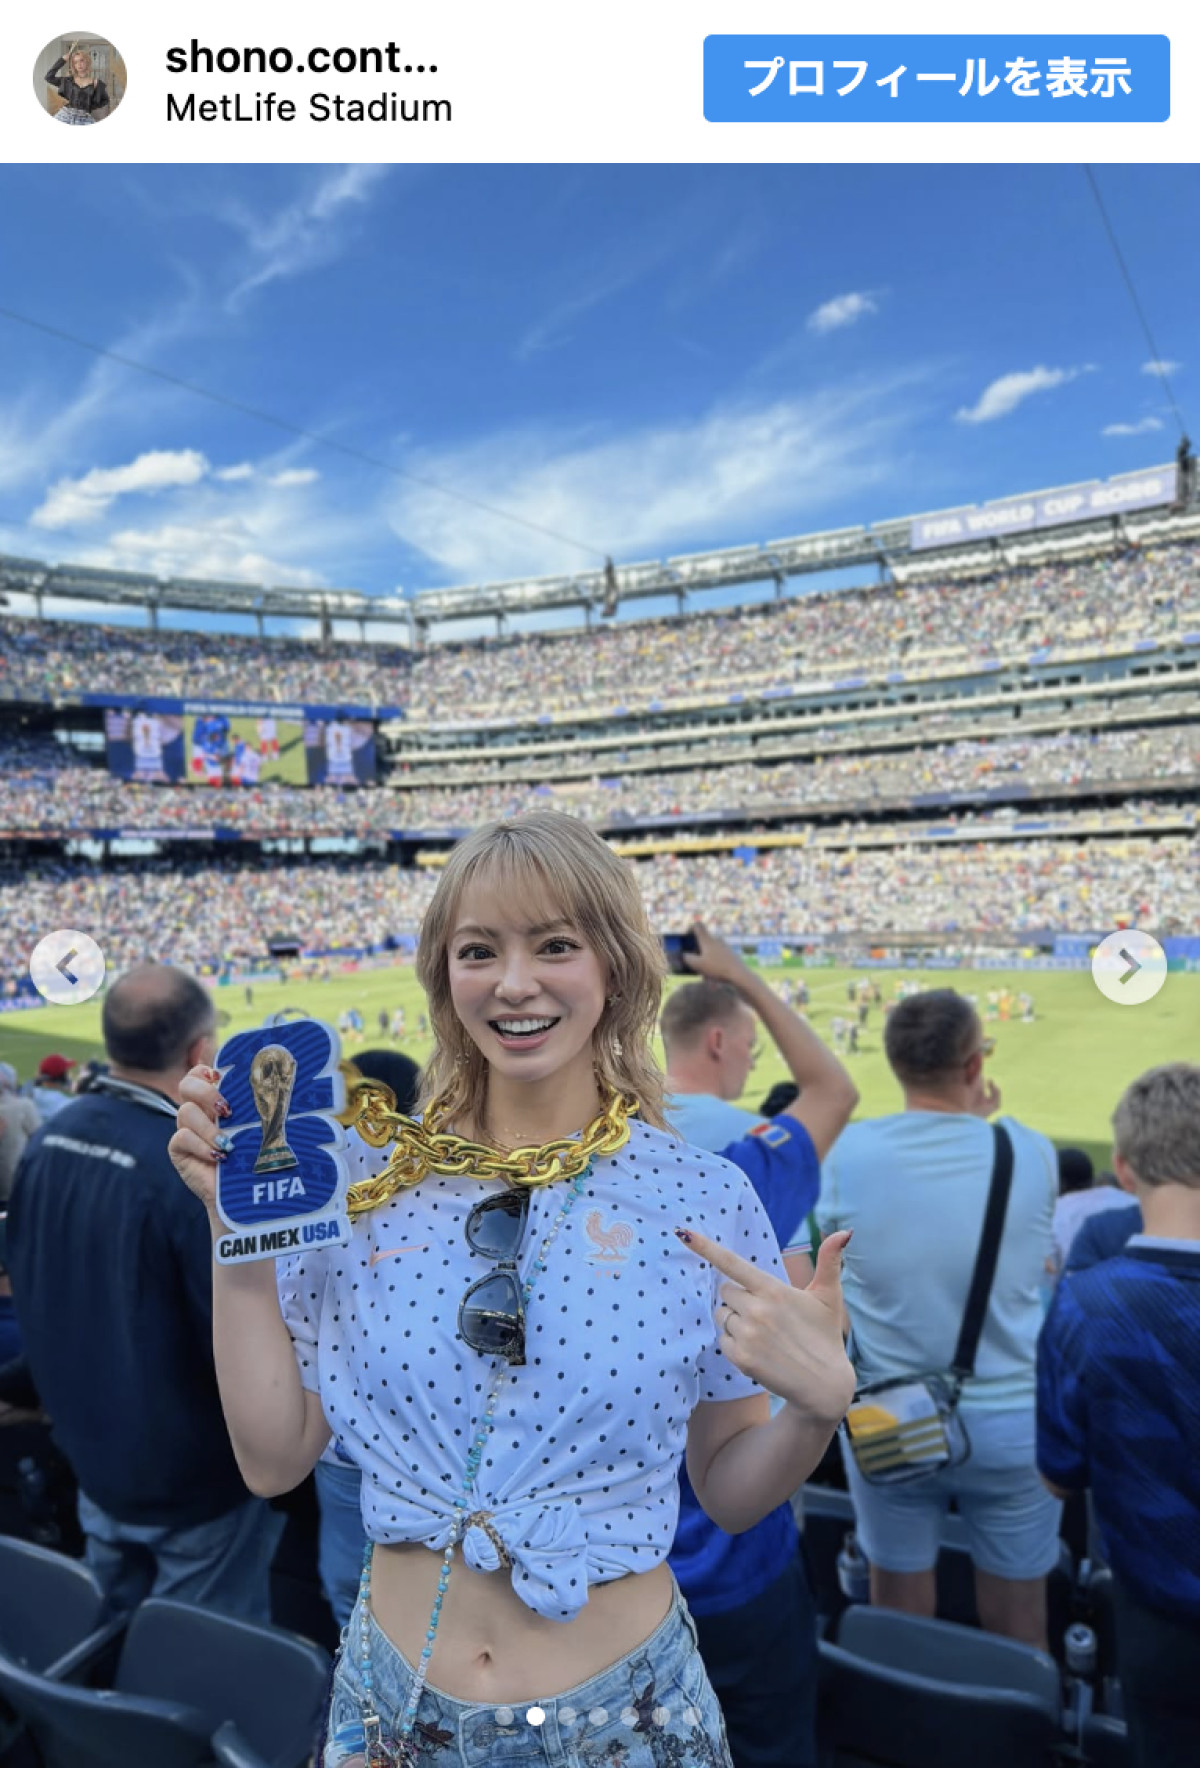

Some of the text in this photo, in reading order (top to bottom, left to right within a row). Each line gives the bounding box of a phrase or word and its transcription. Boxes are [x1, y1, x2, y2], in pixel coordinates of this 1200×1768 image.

[253, 1177, 306, 1205] FIFA
[220, 1220, 341, 1258] CAN MEX USA
